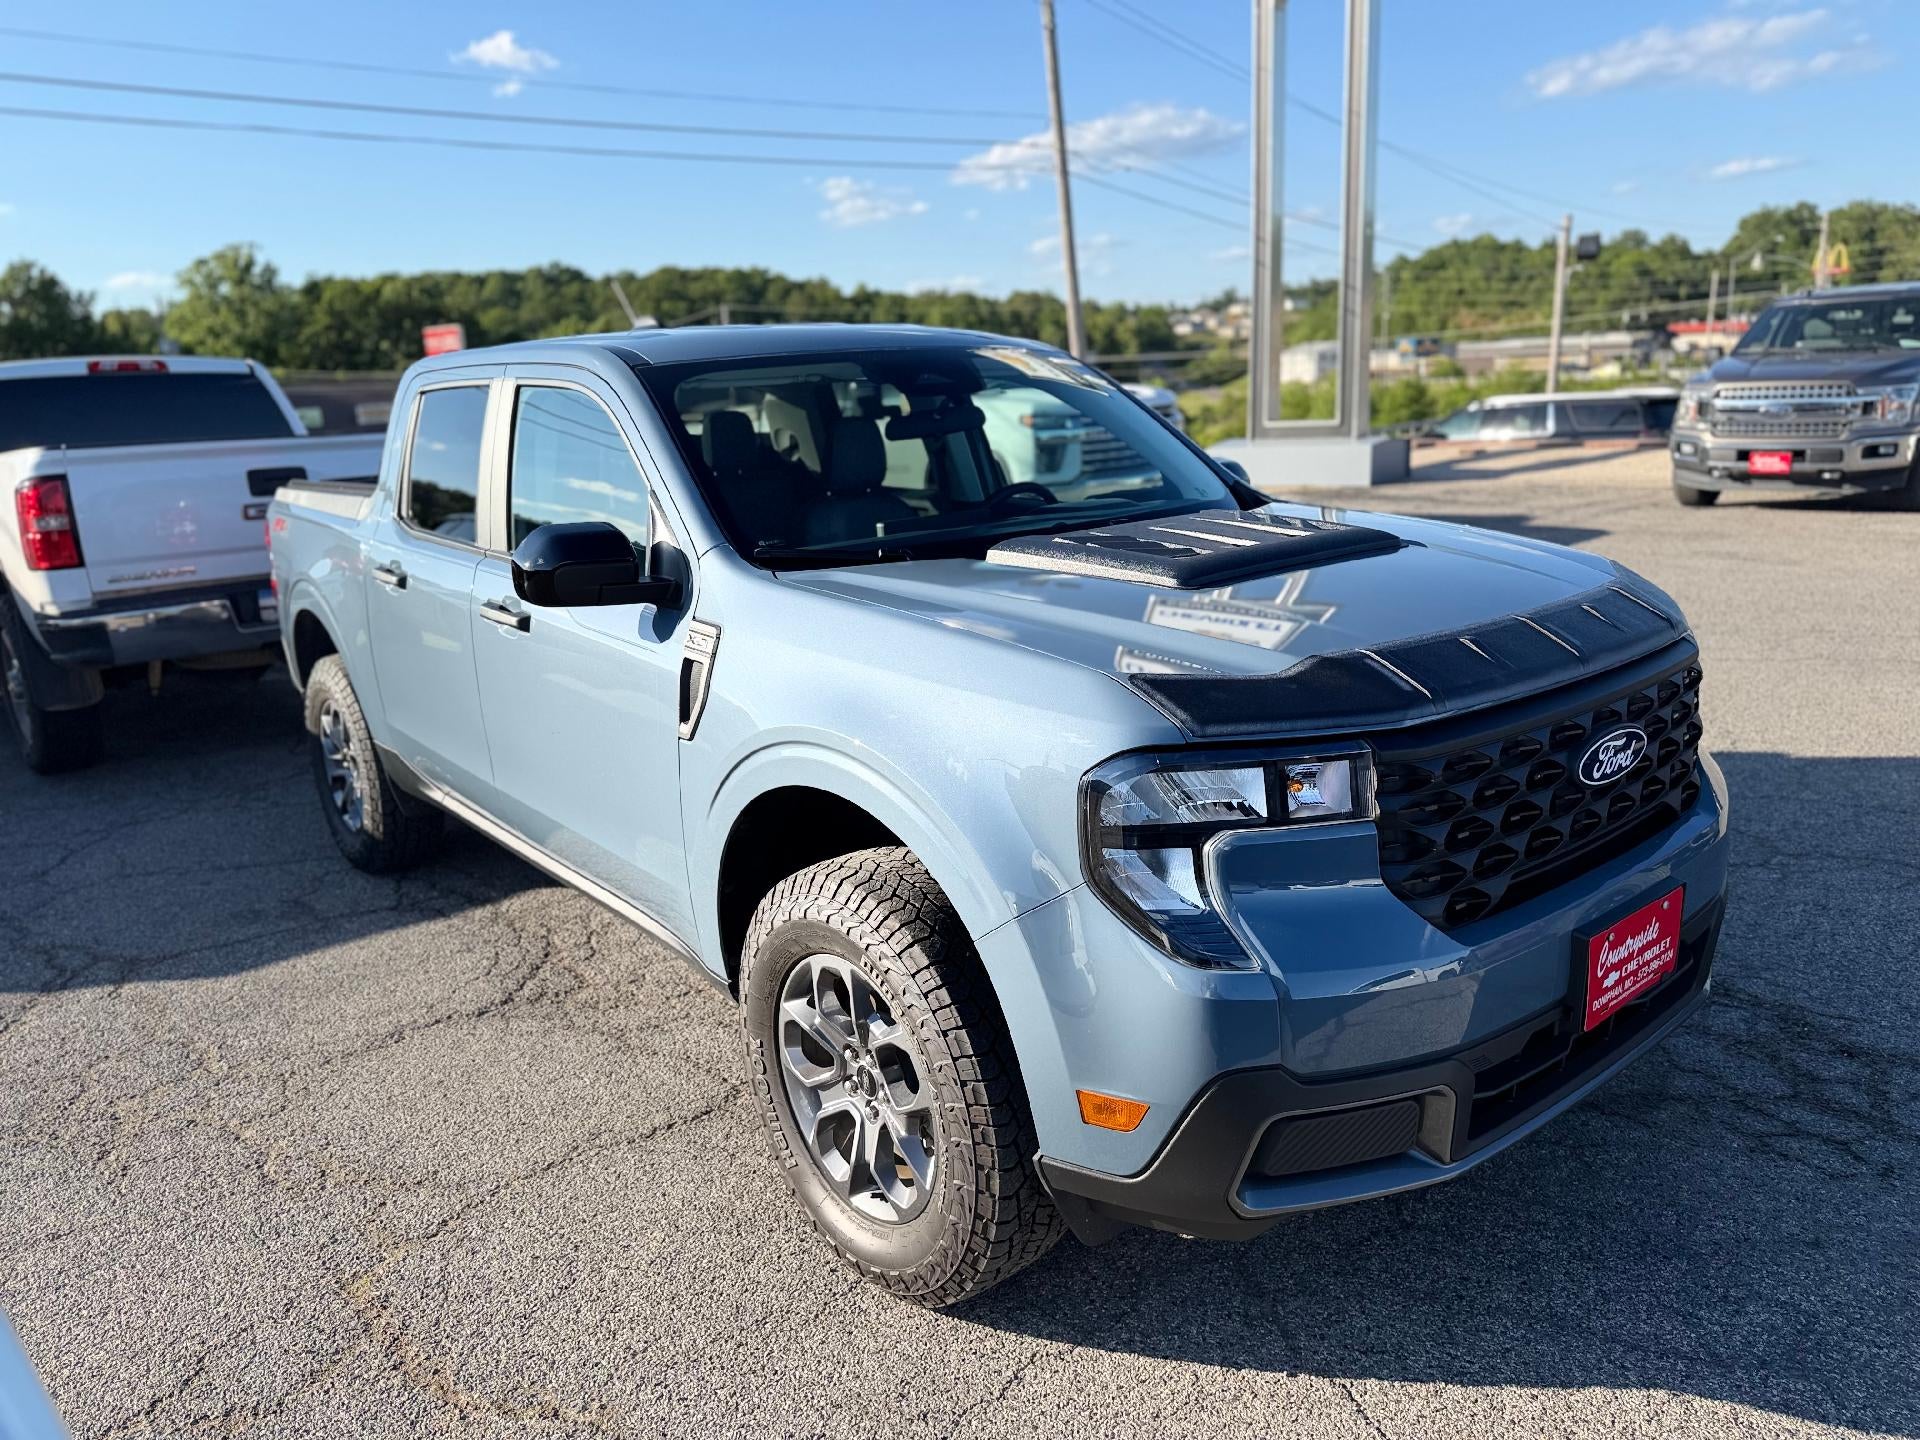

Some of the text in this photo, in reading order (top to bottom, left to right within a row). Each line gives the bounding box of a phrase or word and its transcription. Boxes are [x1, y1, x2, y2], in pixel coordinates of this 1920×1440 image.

[1592, 736, 1637, 779] Ford
[1597, 915, 1660, 979] Countryside
[1621, 936, 1672, 976] CHEVROLET
